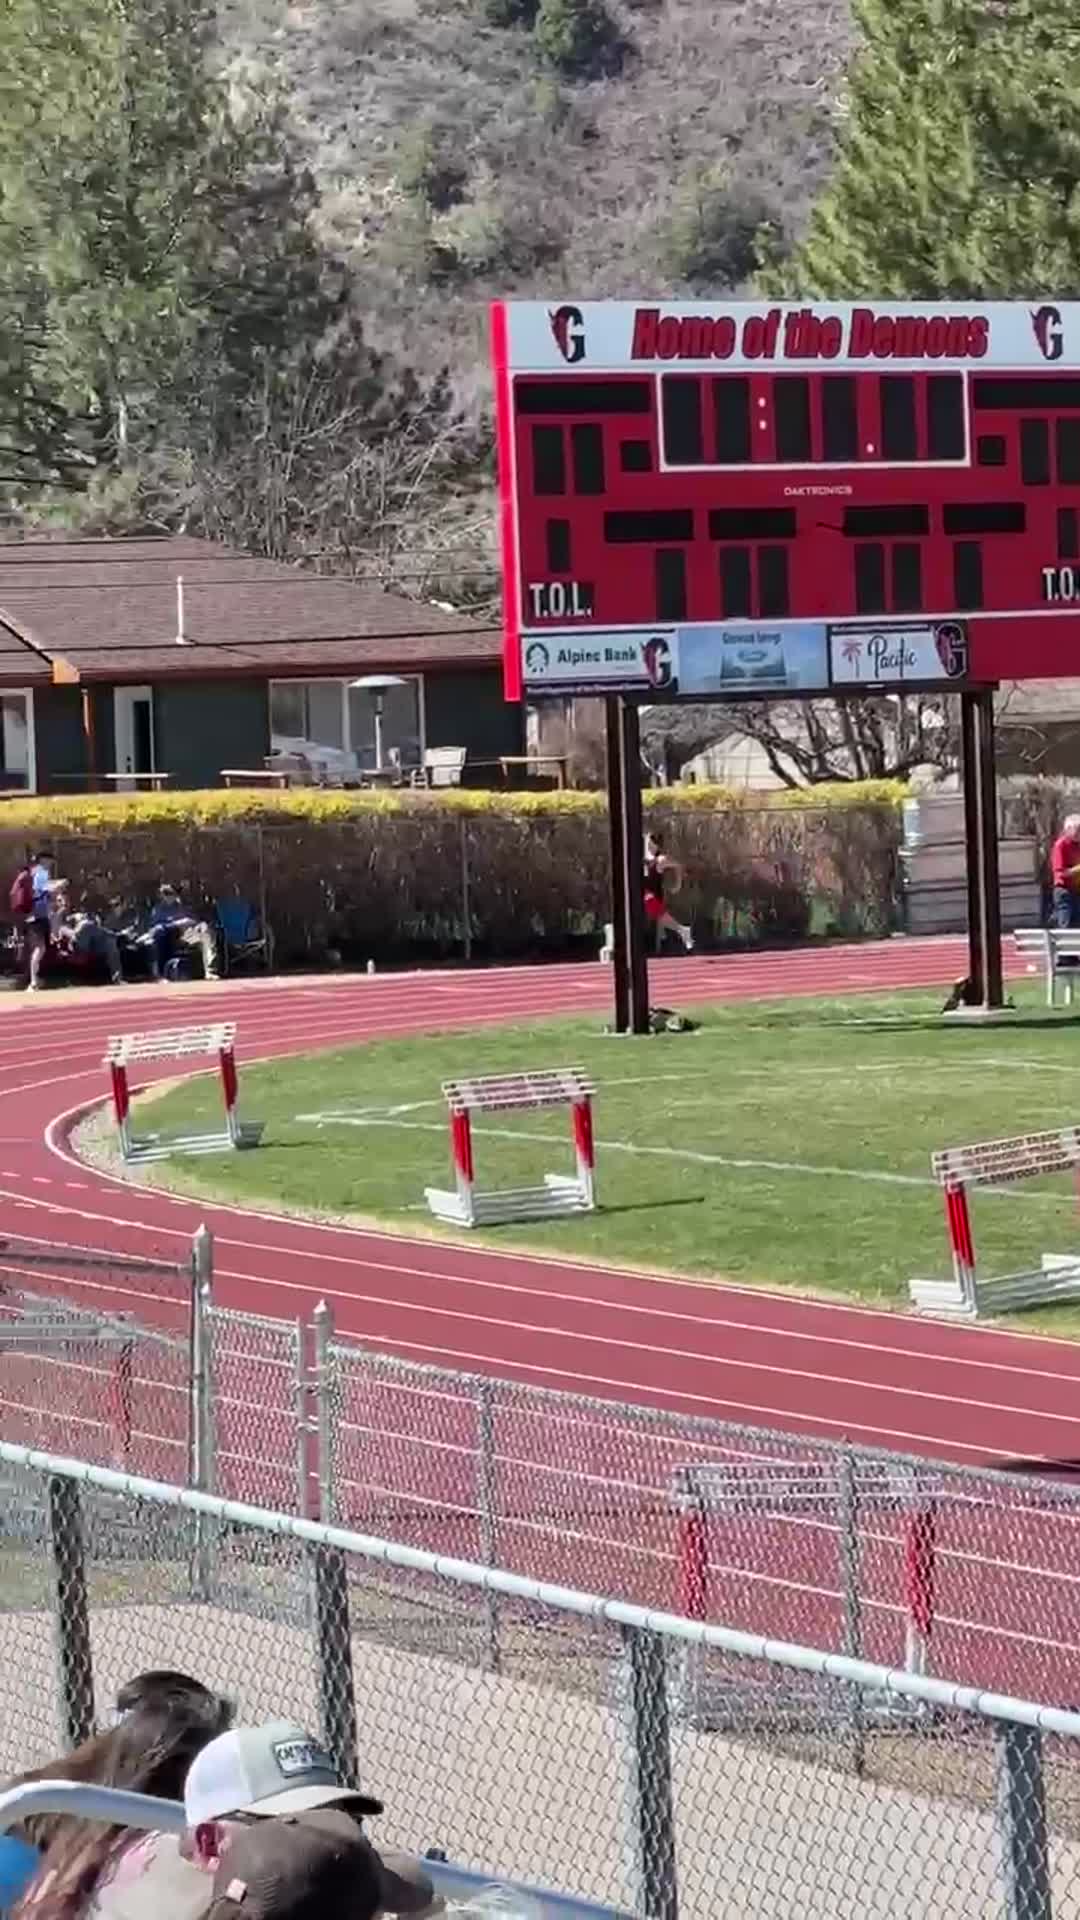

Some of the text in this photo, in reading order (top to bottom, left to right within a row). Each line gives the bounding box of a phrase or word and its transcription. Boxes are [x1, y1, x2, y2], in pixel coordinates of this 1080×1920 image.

[548, 305, 586, 363] G
[631, 308, 990, 360] Home of the Demons
[1031, 305, 1063, 361] G
[529, 582, 592, 618] T.O.L.
[557, 645, 637, 667] Alpine Bank
[867, 634, 918, 679] Pacific
